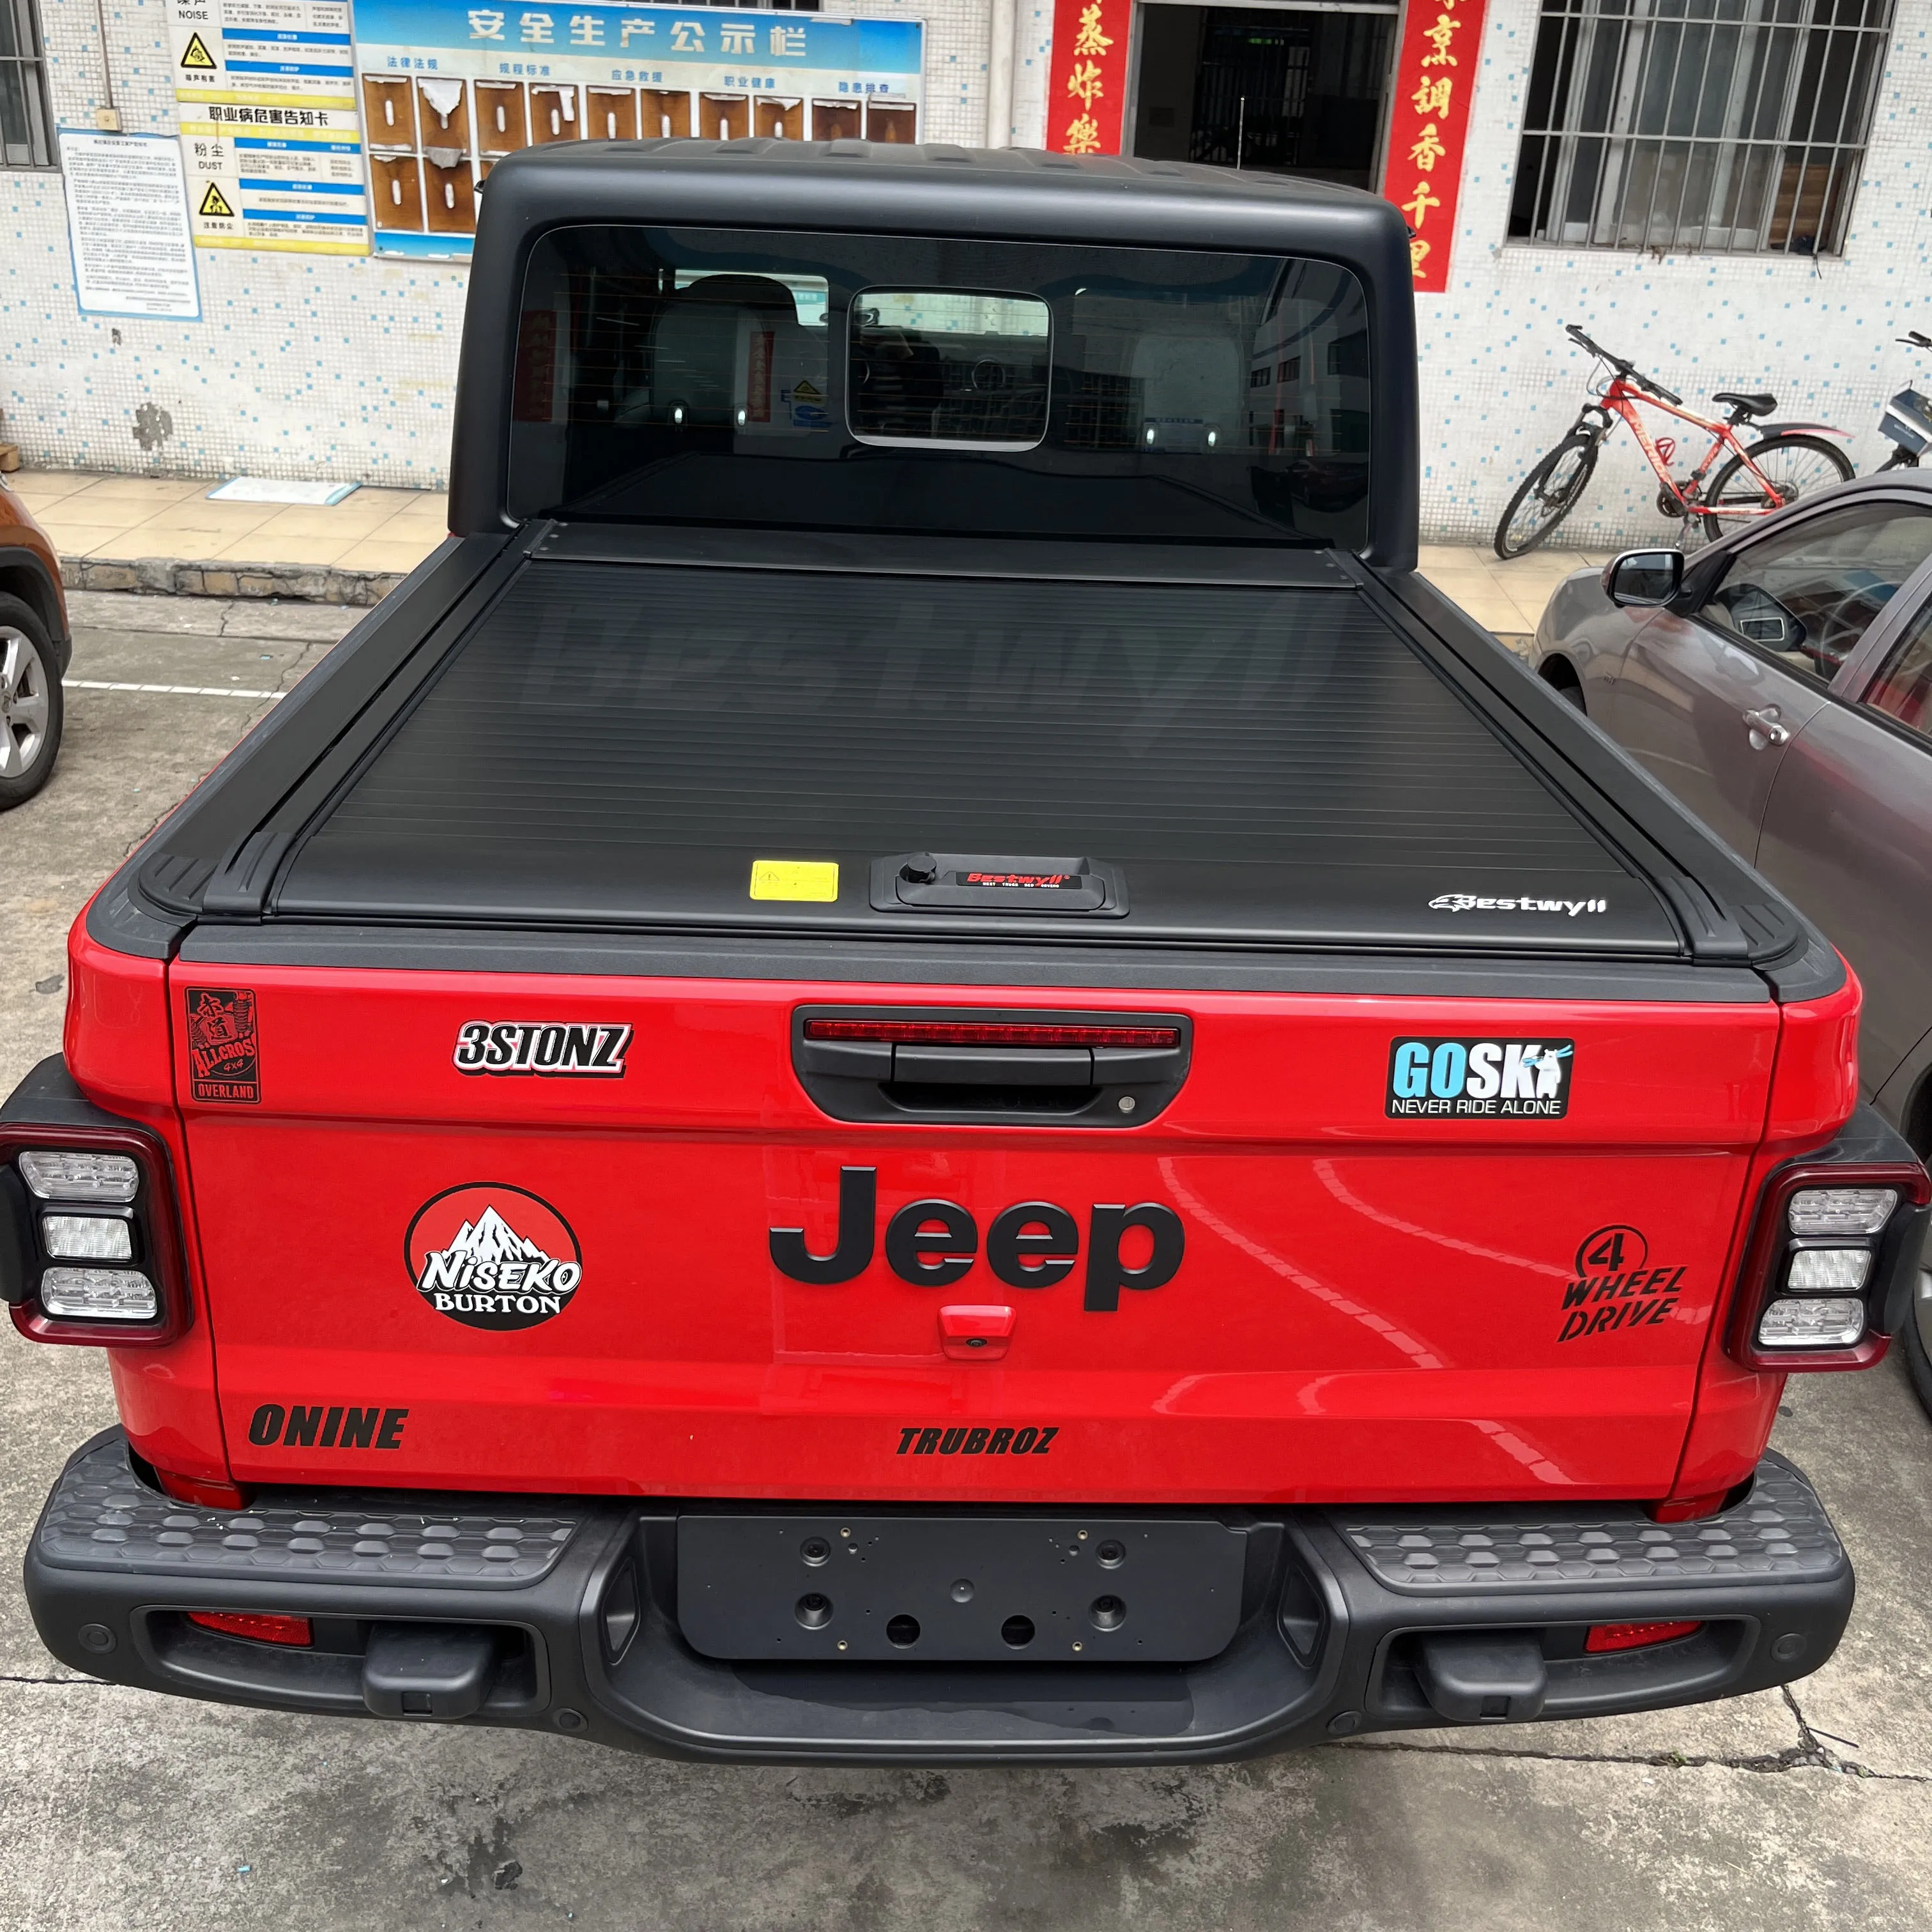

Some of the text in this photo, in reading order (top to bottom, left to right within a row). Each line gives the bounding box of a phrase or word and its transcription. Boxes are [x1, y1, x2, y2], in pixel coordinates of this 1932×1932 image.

[178, 10, 208, 20] NOISE
[468, 9, 806, 56] 安全生产公示栏
[1063, 0, 1114, 155] 蒸炸樂
[209, 106, 328, 126] 职业病危害告知卡
[194, 143, 224, 157] 粉尘
[1401, 0, 1463, 279] 烹調香千里
[199, 161, 222, 170] DUST
[192, 1036, 256, 1078] ALLCROS
[454, 1021, 630, 1071] 3STONZ
[197, 1083, 254, 1099] OVERLAND
[1392, 1100, 1561, 1114] NEVER RIDE ALONE
[769, 1166, 1186, 1312] Jeep
[1588, 1232, 1625, 1271] 4
[434, 1292, 561, 1314] BURTON
[1561, 1266, 1687, 1310] WHEEL
[1557, 1298, 1679, 1342] DRIVE
[248, 1404, 409, 1449] ONINE
[896, 1427, 1060, 1454] TRUBROZ
